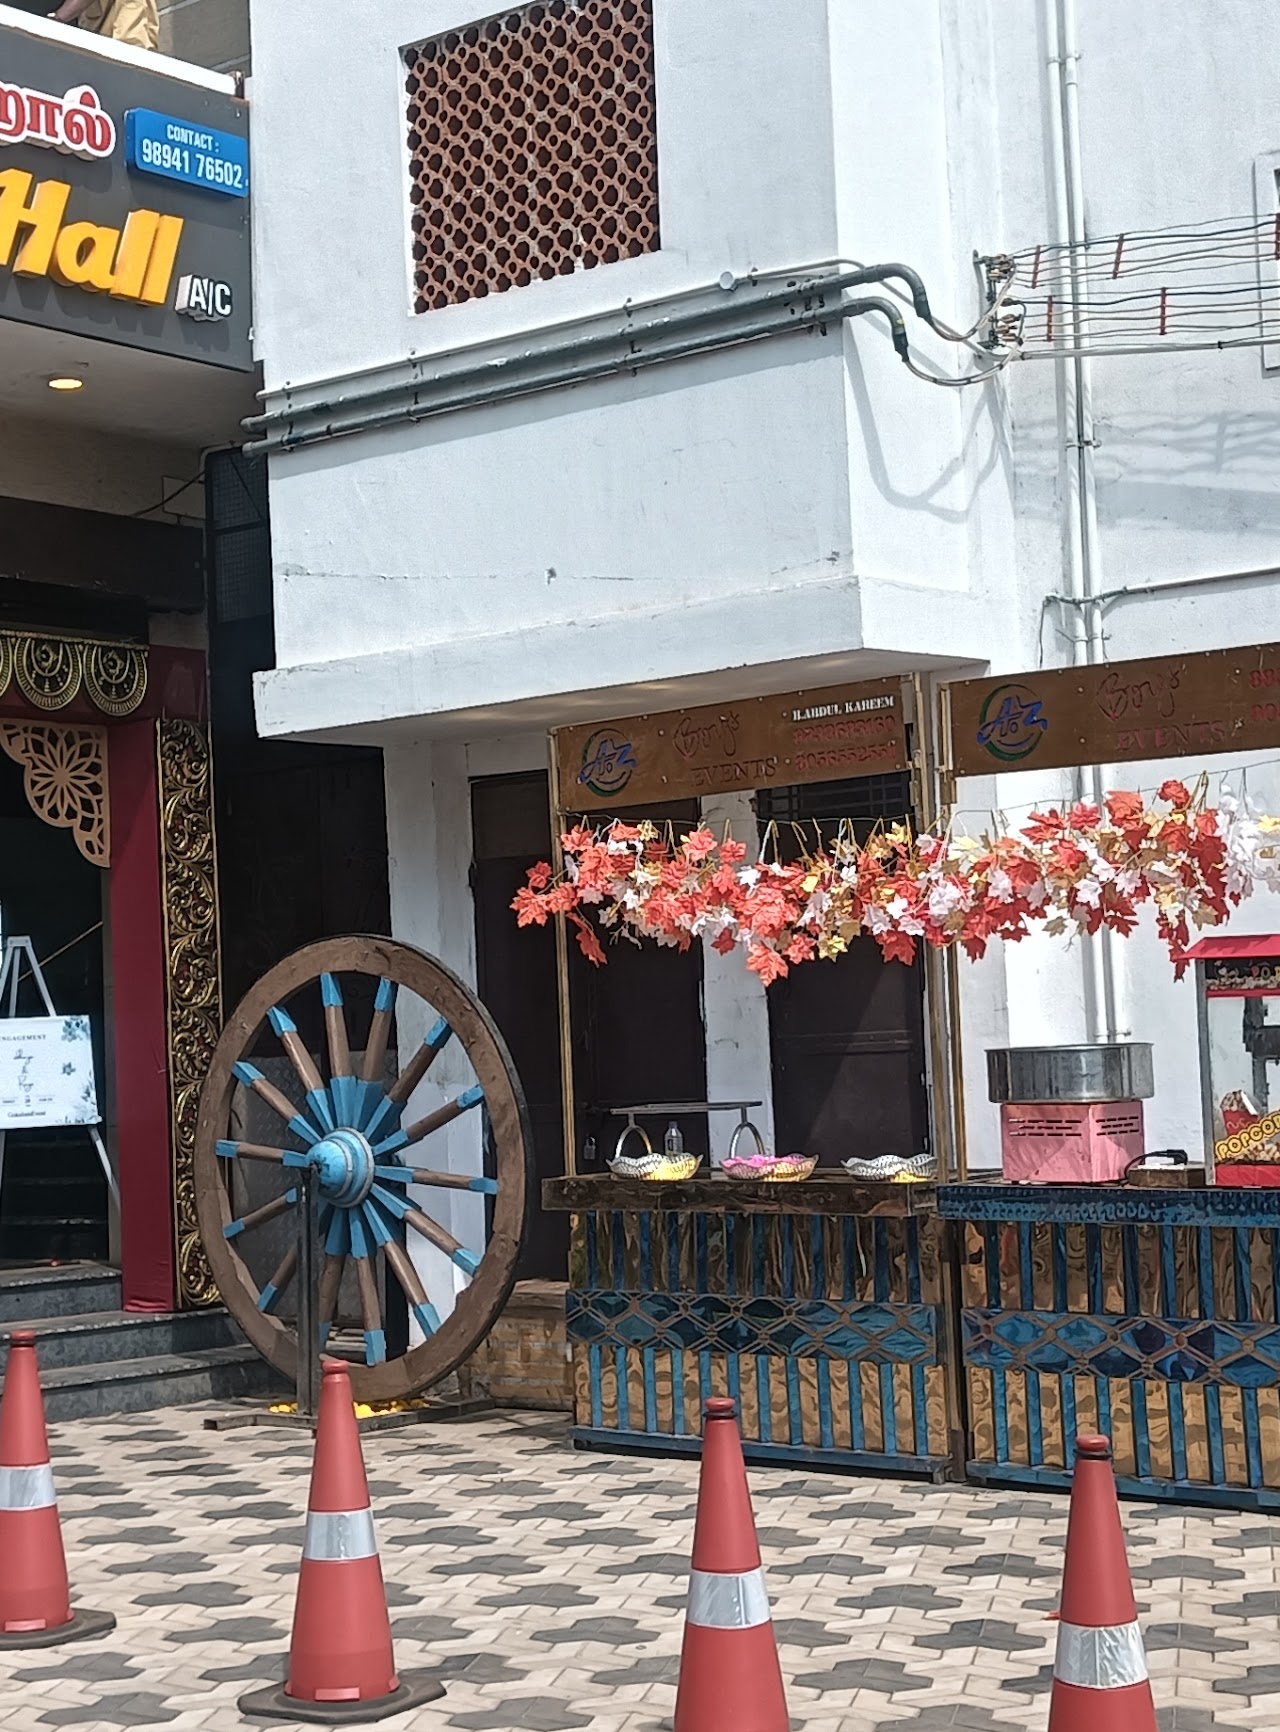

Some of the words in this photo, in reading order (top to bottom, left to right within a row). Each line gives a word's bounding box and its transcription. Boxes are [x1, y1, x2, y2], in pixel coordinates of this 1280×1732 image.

[166, 123, 214, 151] CONTACT
[141, 138, 190, 174] 98941
[195, 153, 243, 189] 76502
[844, 695, 895, 714] KAREEM
[1115, 720, 1225, 752] EVENTS
